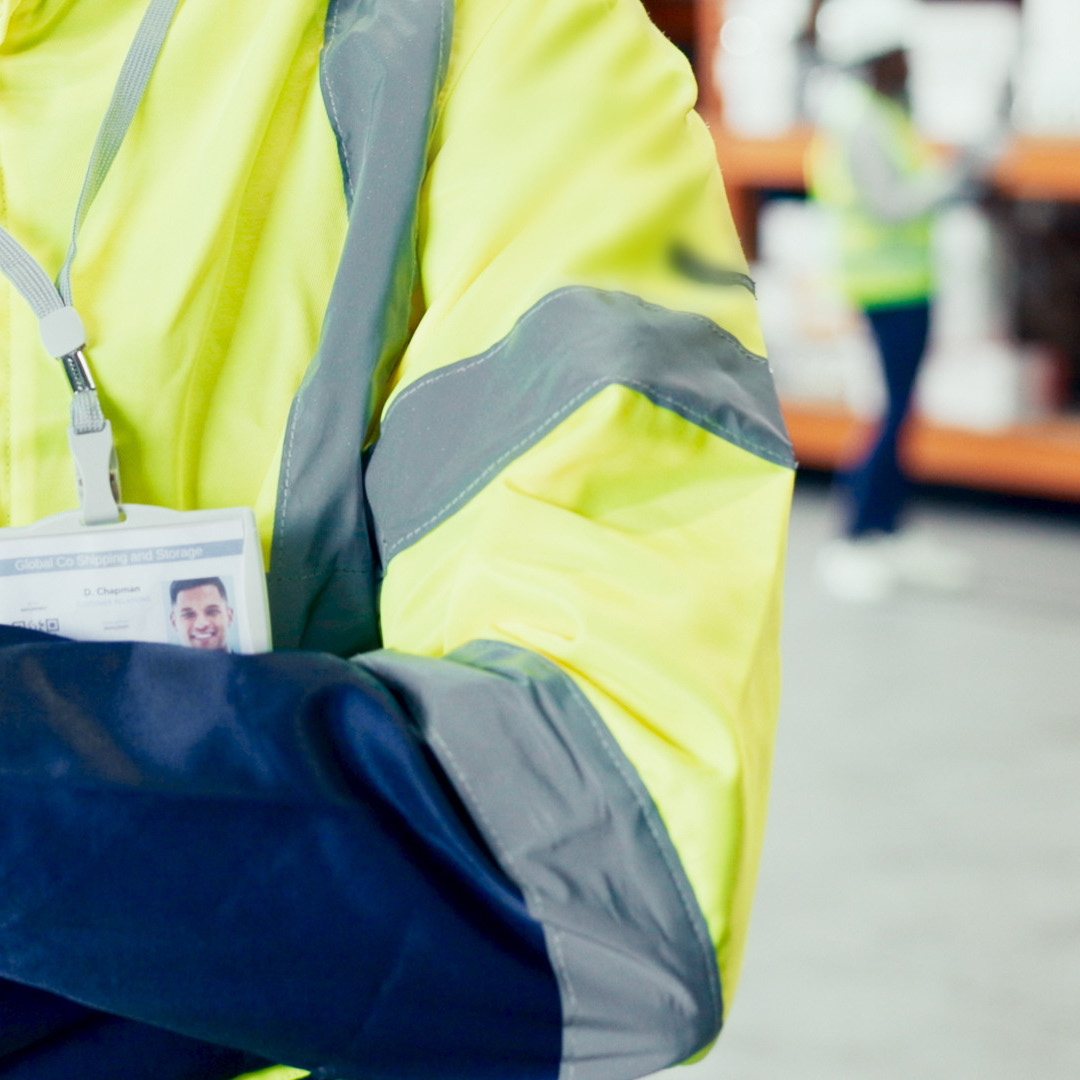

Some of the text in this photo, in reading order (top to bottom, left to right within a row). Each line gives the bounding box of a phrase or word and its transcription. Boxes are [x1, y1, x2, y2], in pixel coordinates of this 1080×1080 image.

[15, 547, 203, 572] Global Co Shipping and Storage
[83, 585, 141, 597] D. Chapman
